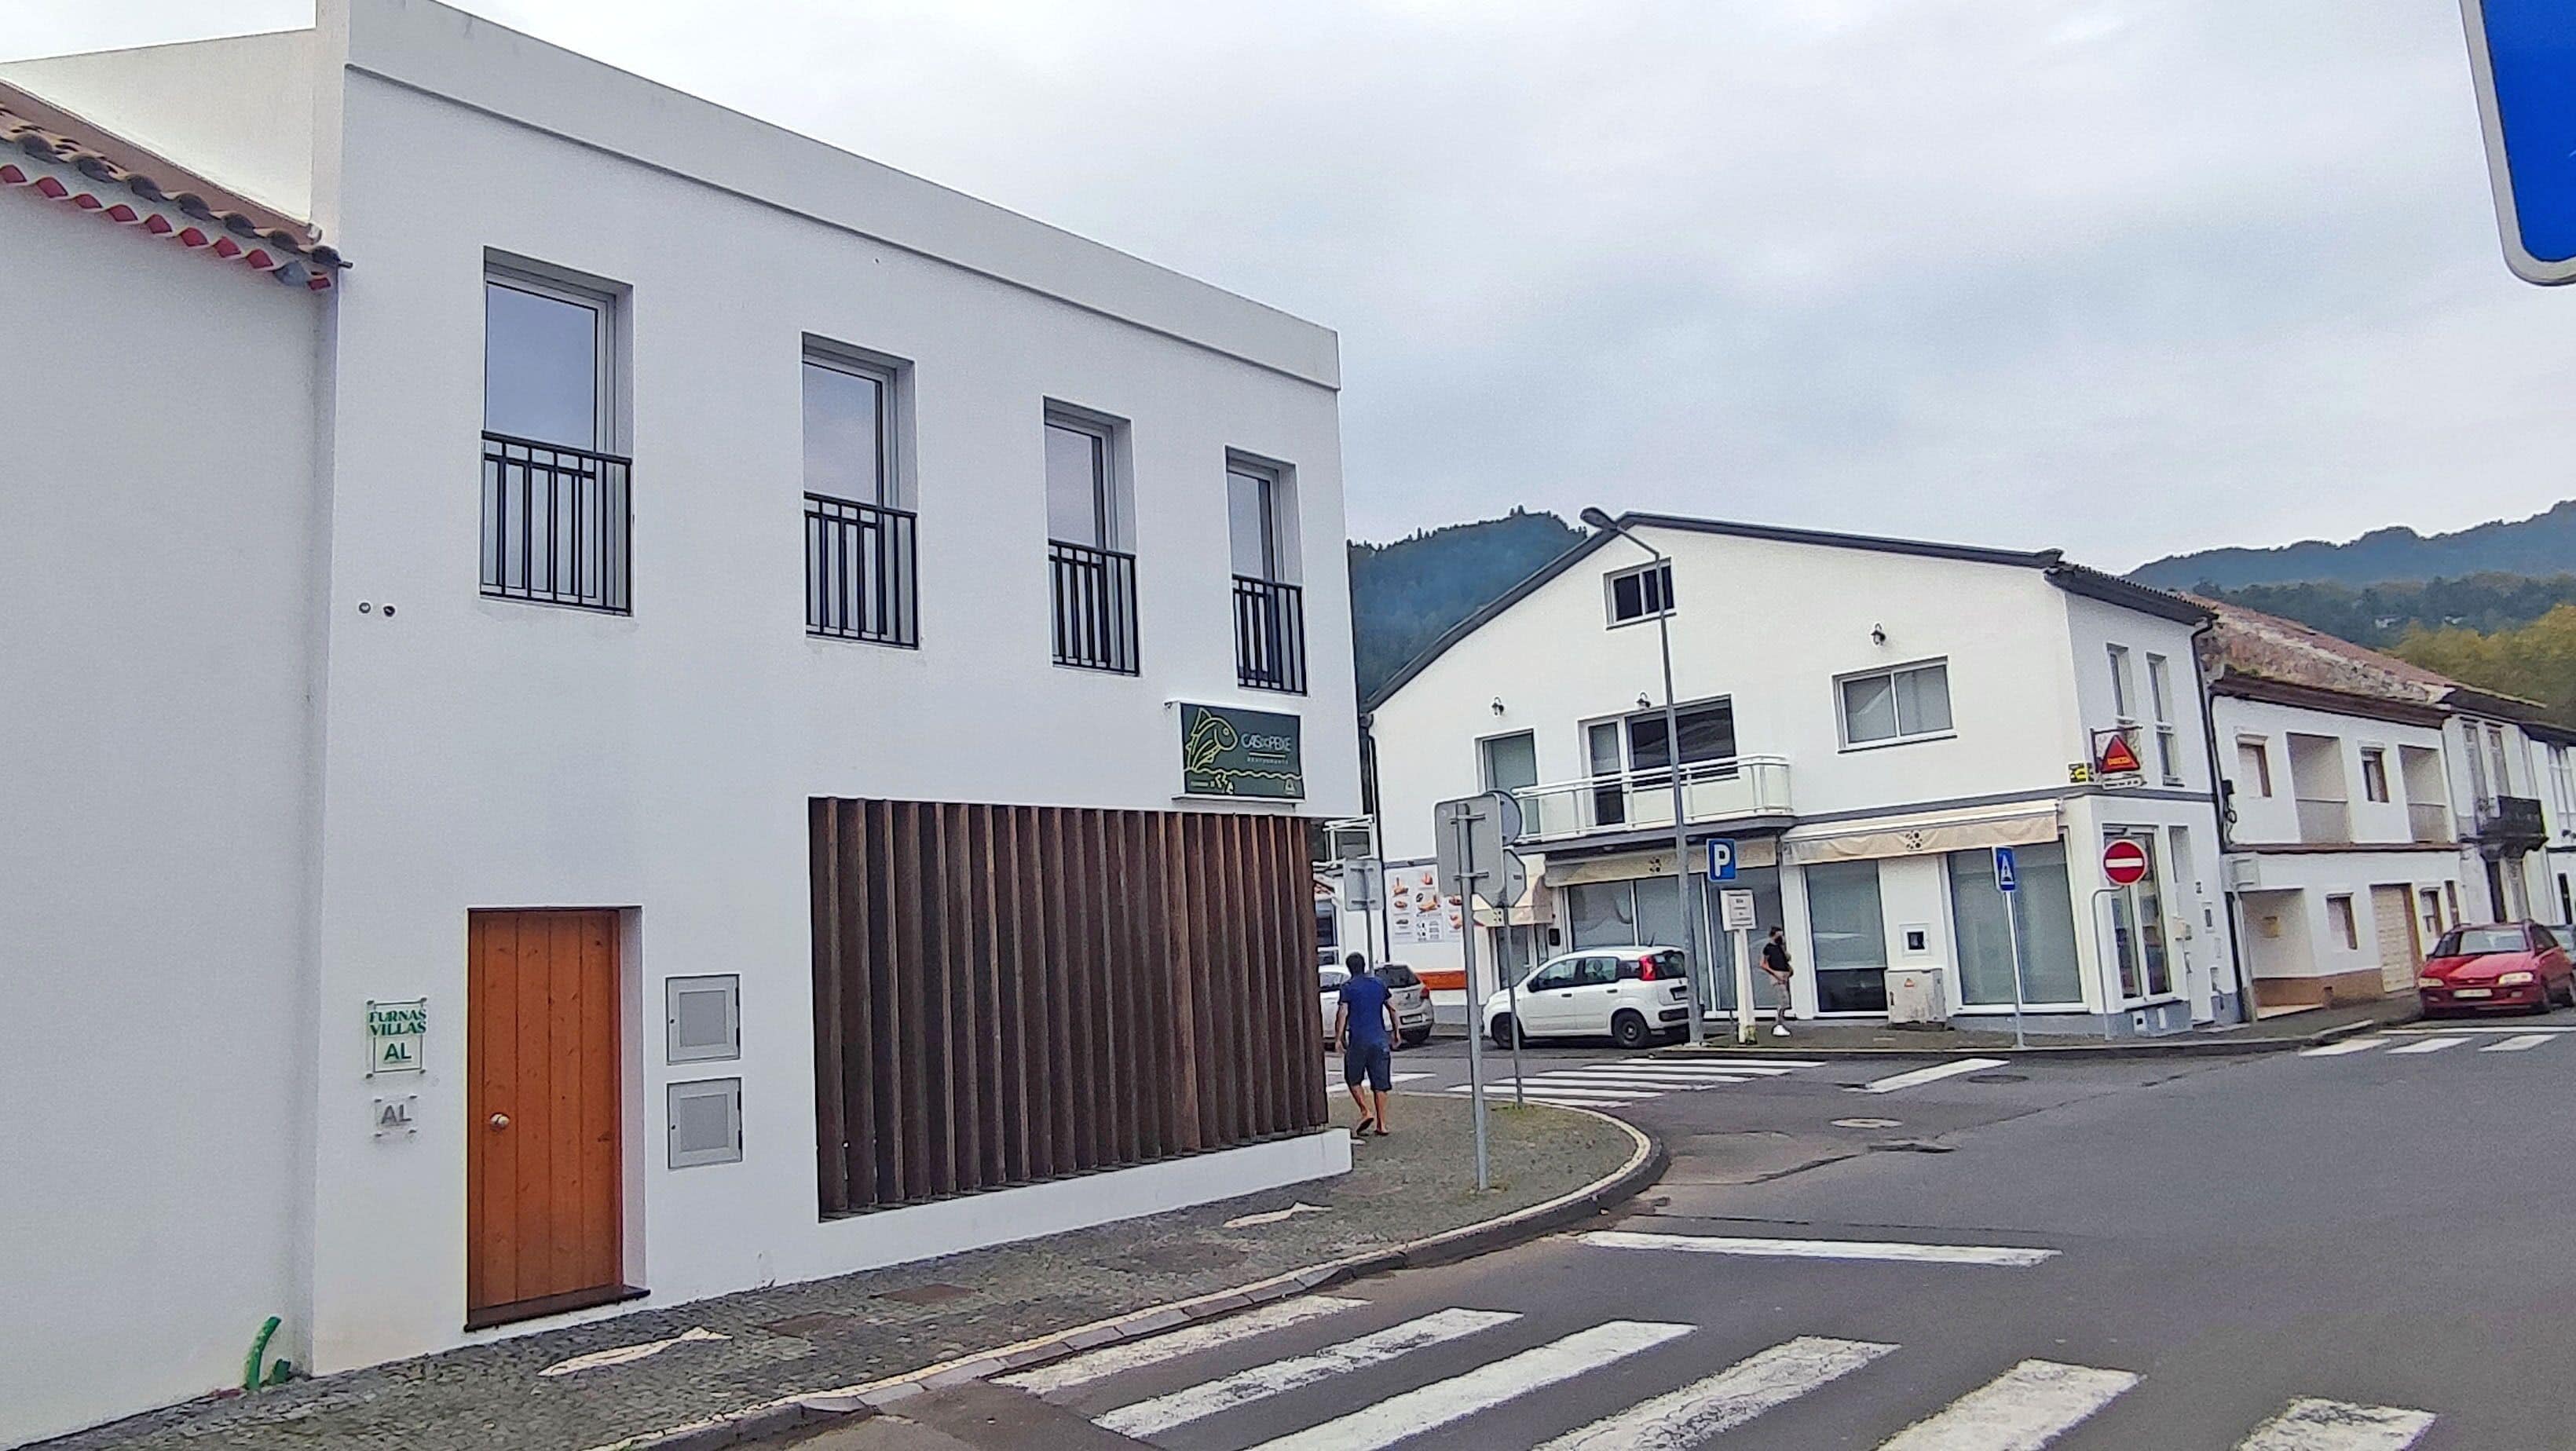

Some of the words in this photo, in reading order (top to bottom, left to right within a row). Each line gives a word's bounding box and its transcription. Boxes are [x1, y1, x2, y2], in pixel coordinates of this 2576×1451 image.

[1714, 844, 1730, 877] P
[369, 1010, 426, 1022] FURNAS
[370, 1022, 426, 1036] VILLAS
[384, 1043, 412, 1061] AL
[381, 1104, 412, 1124] AL
